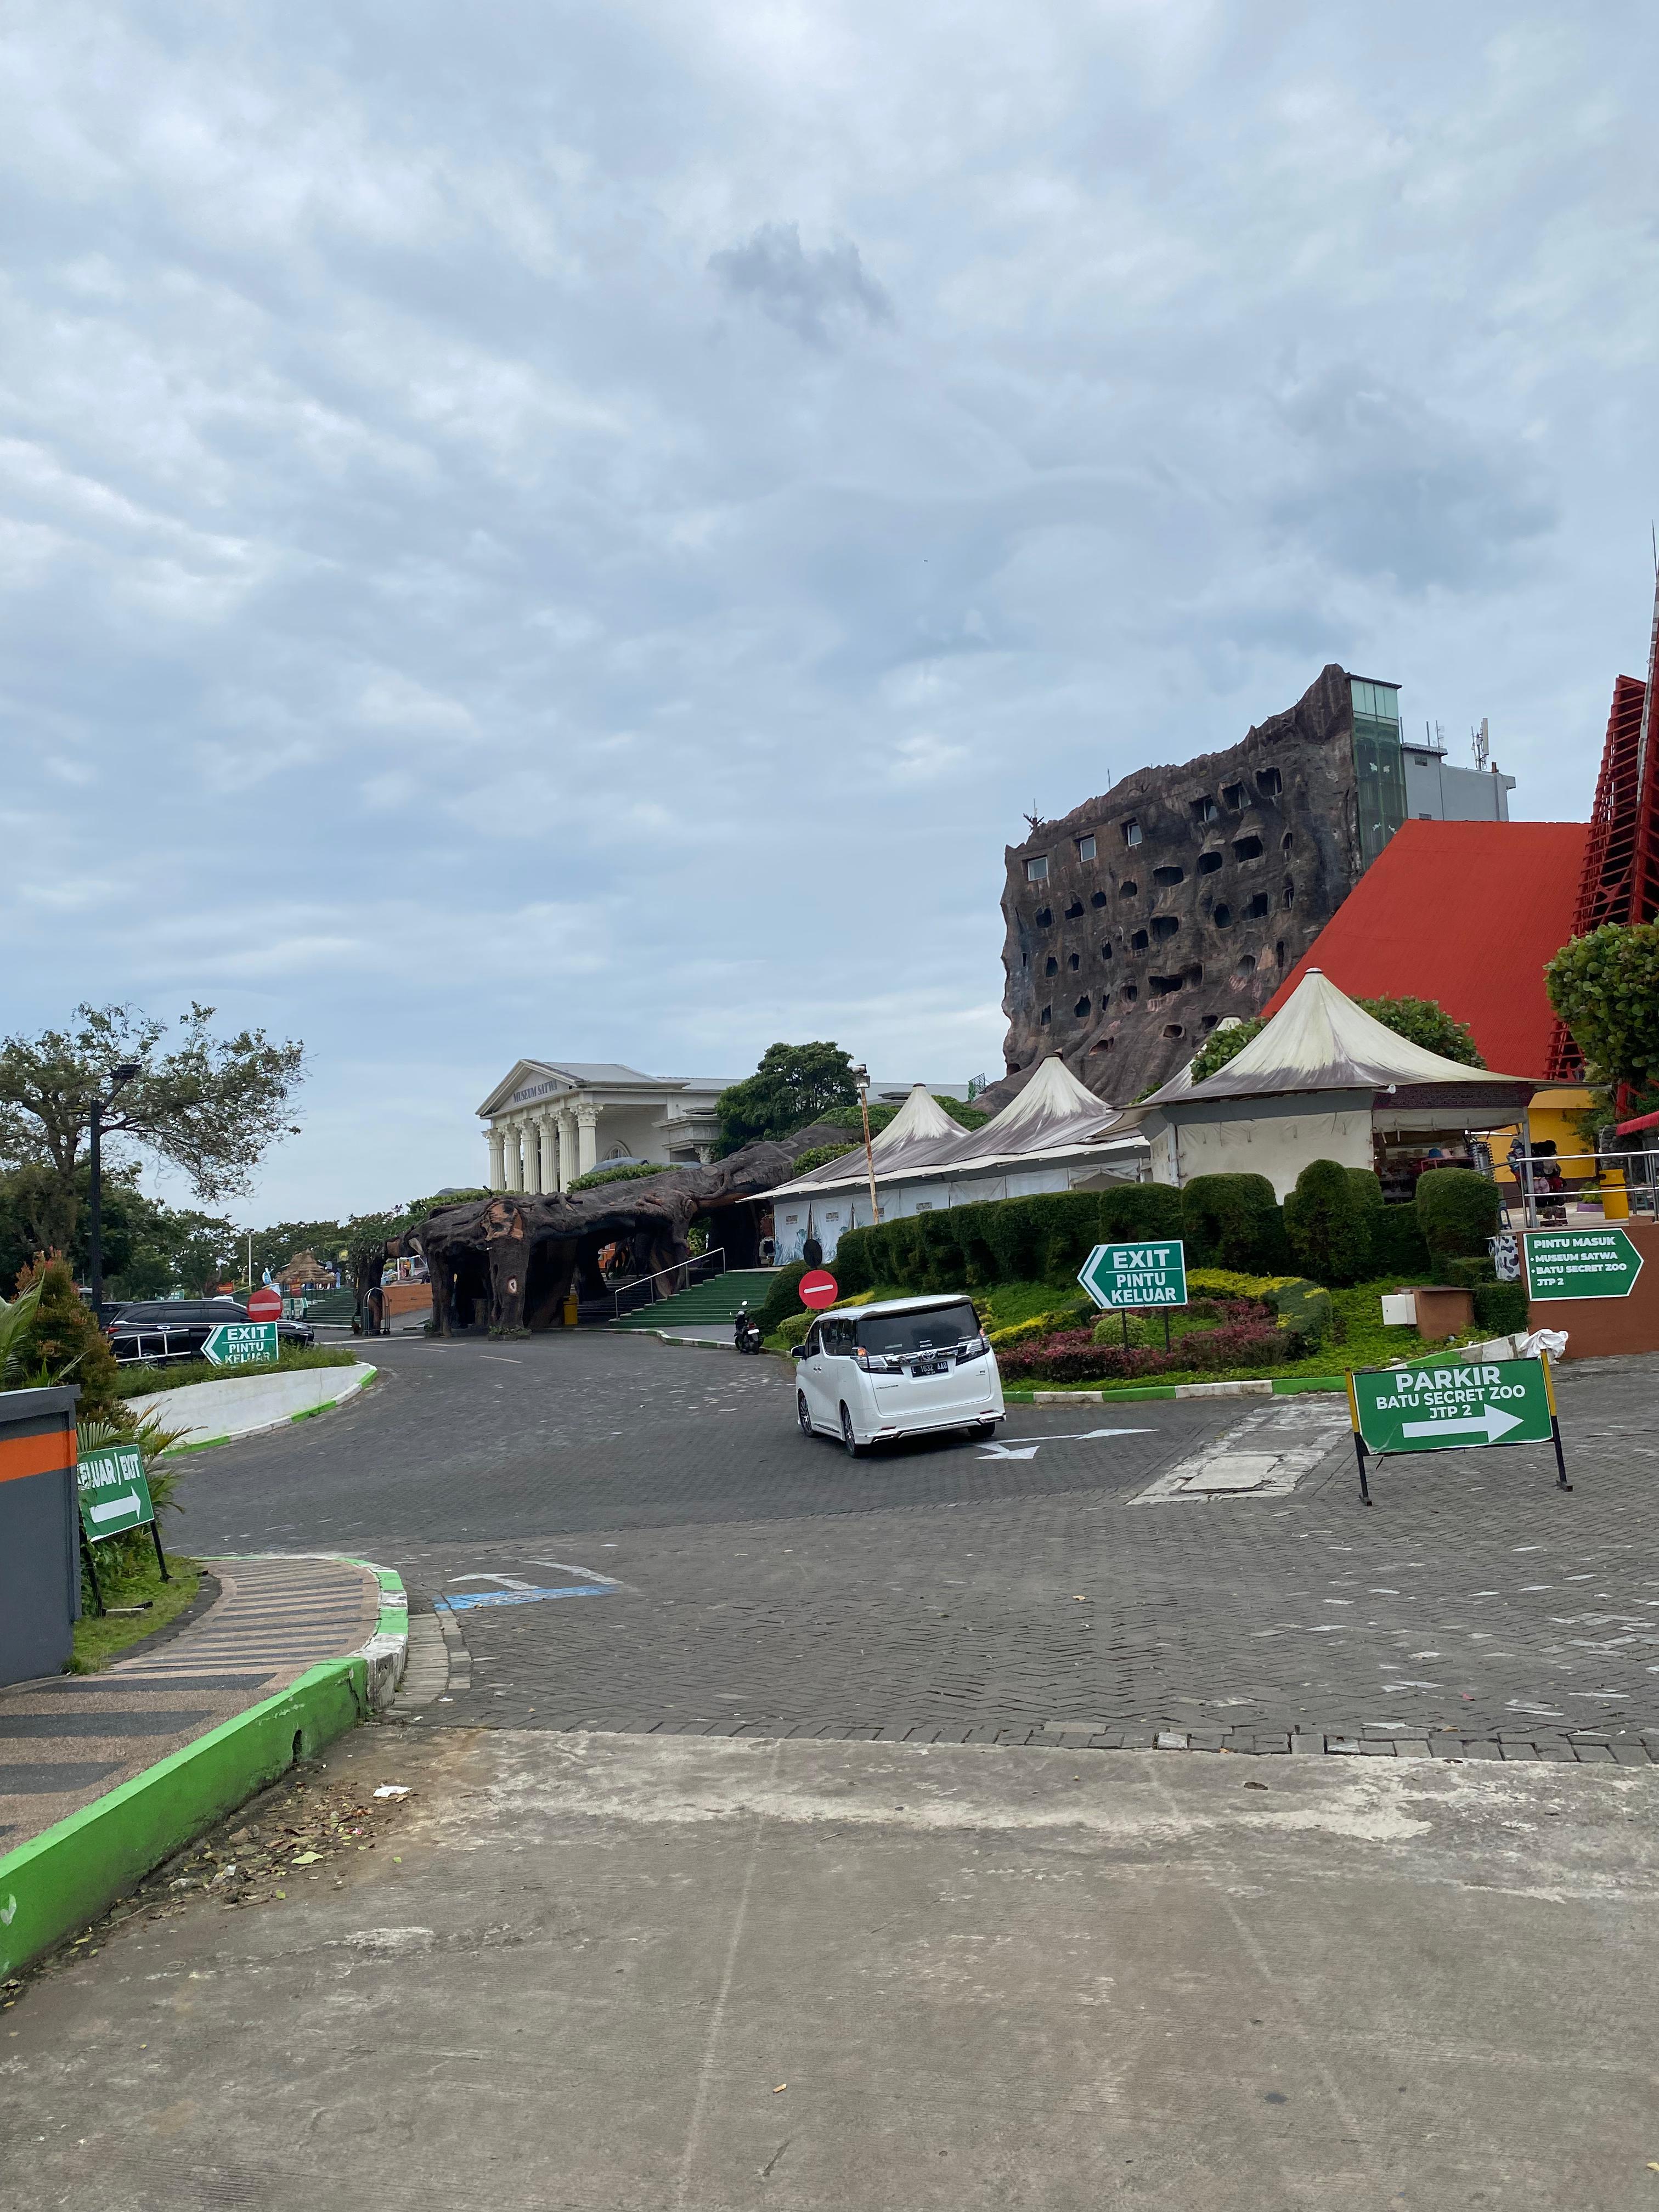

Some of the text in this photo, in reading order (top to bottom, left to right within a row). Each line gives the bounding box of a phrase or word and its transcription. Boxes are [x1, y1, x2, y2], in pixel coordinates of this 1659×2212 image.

[513, 1079, 558, 1103] MUSEUM SATWA
[1533, 1237, 1616, 1249] PINTU MASUK
[1113, 1249, 1170, 1269] EXIT
[1535, 1251, 1618, 1262] MUSEUM SATWA
[1536, 1263, 1627, 1274] BATU SECRET ZOO
[1116, 1272, 1166, 1288] PINTU
[1537, 1278, 1556, 1286] JTP
[1111, 1287, 1176, 1304] KELUAR
[227, 1326, 268, 1341] EXIT
[229, 1341, 264, 1353] PINTU
[224, 1352, 270, 1364] KELUAR
[920, 1364, 934, 1373] 1632
[1395, 1365, 1502, 1392] PARKIR
[1376, 1384, 1526, 1410] BATU SECRET ZOO
[1429, 1404, 1472, 1419] JTP 2
[119, 1453, 140, 1481] EXIT
